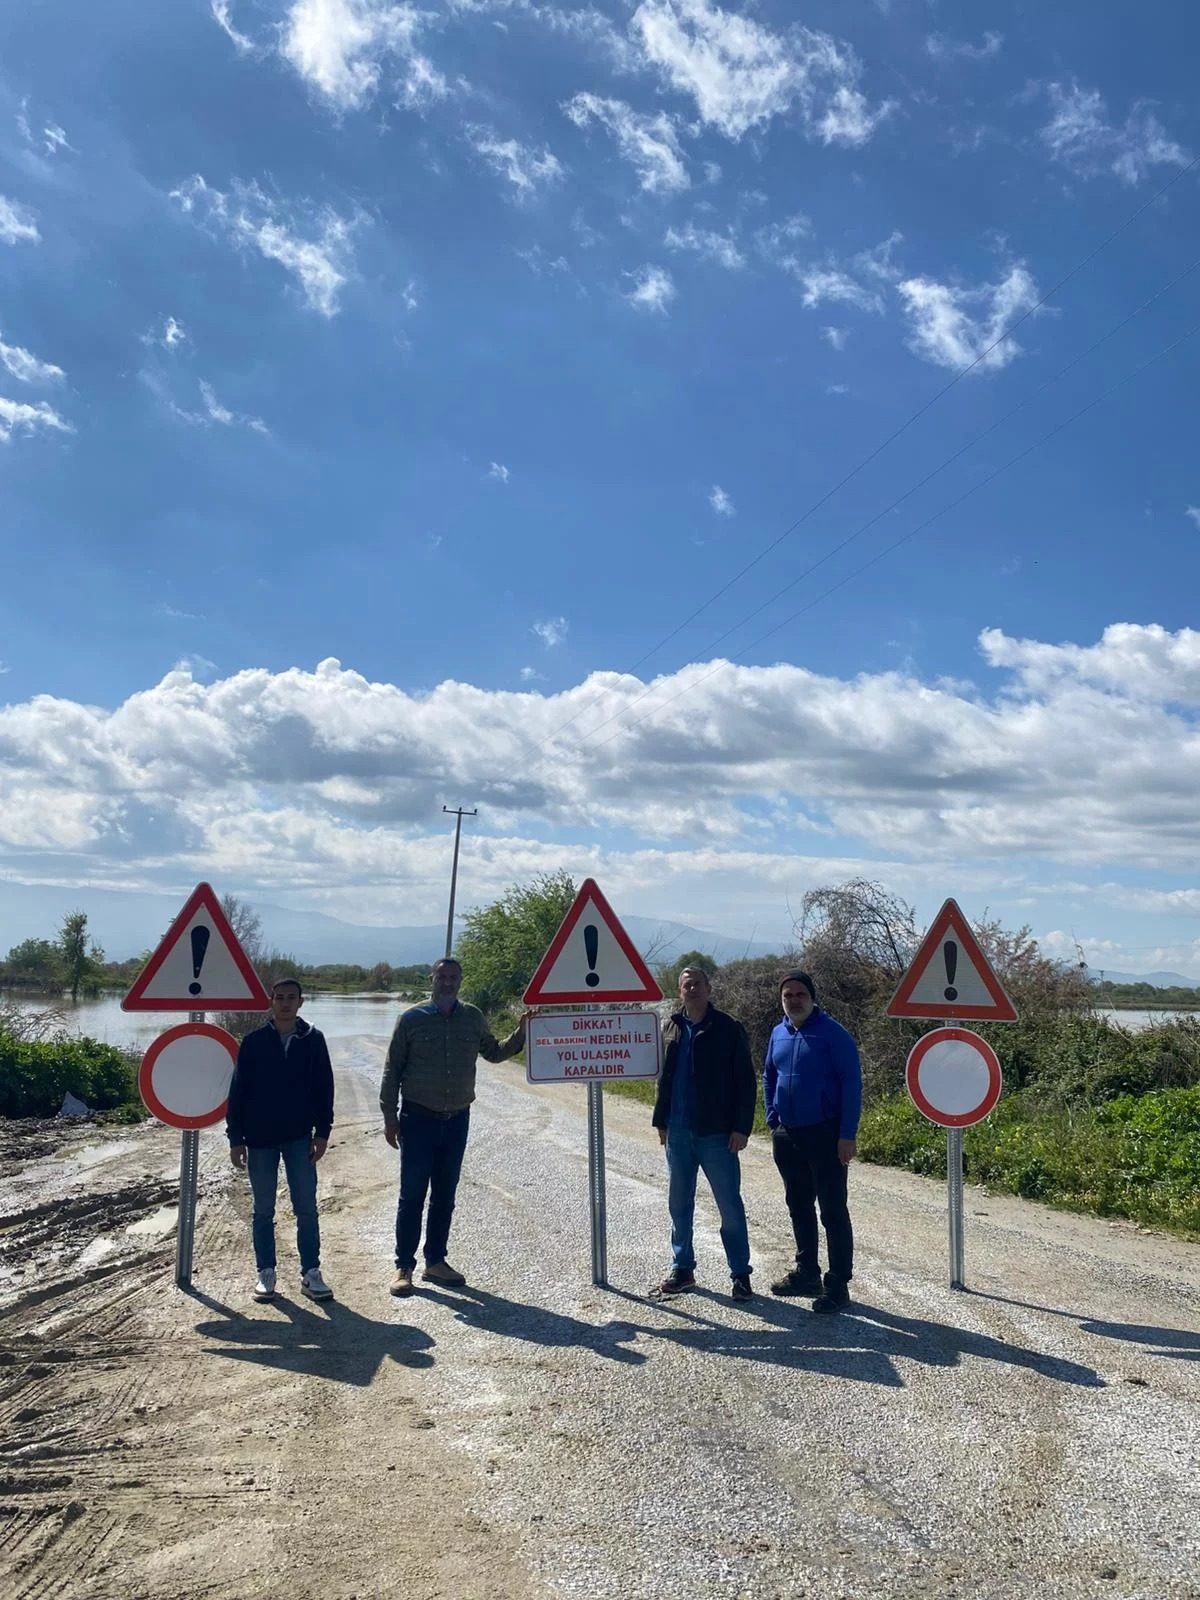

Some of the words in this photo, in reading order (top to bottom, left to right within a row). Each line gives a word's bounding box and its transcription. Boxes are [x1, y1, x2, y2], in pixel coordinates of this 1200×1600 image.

[573, 1018, 613, 1030] DİKKAT
[618, 1017, 622, 1029] !
[590, 1032, 632, 1045] NEDENİ
[634, 1031, 652, 1043] İLE
[557, 1051, 578, 1061] YOL
[581, 1049, 631, 1060] ULAŞIMA
[565, 1065, 624, 1076] KAPALIDIR
